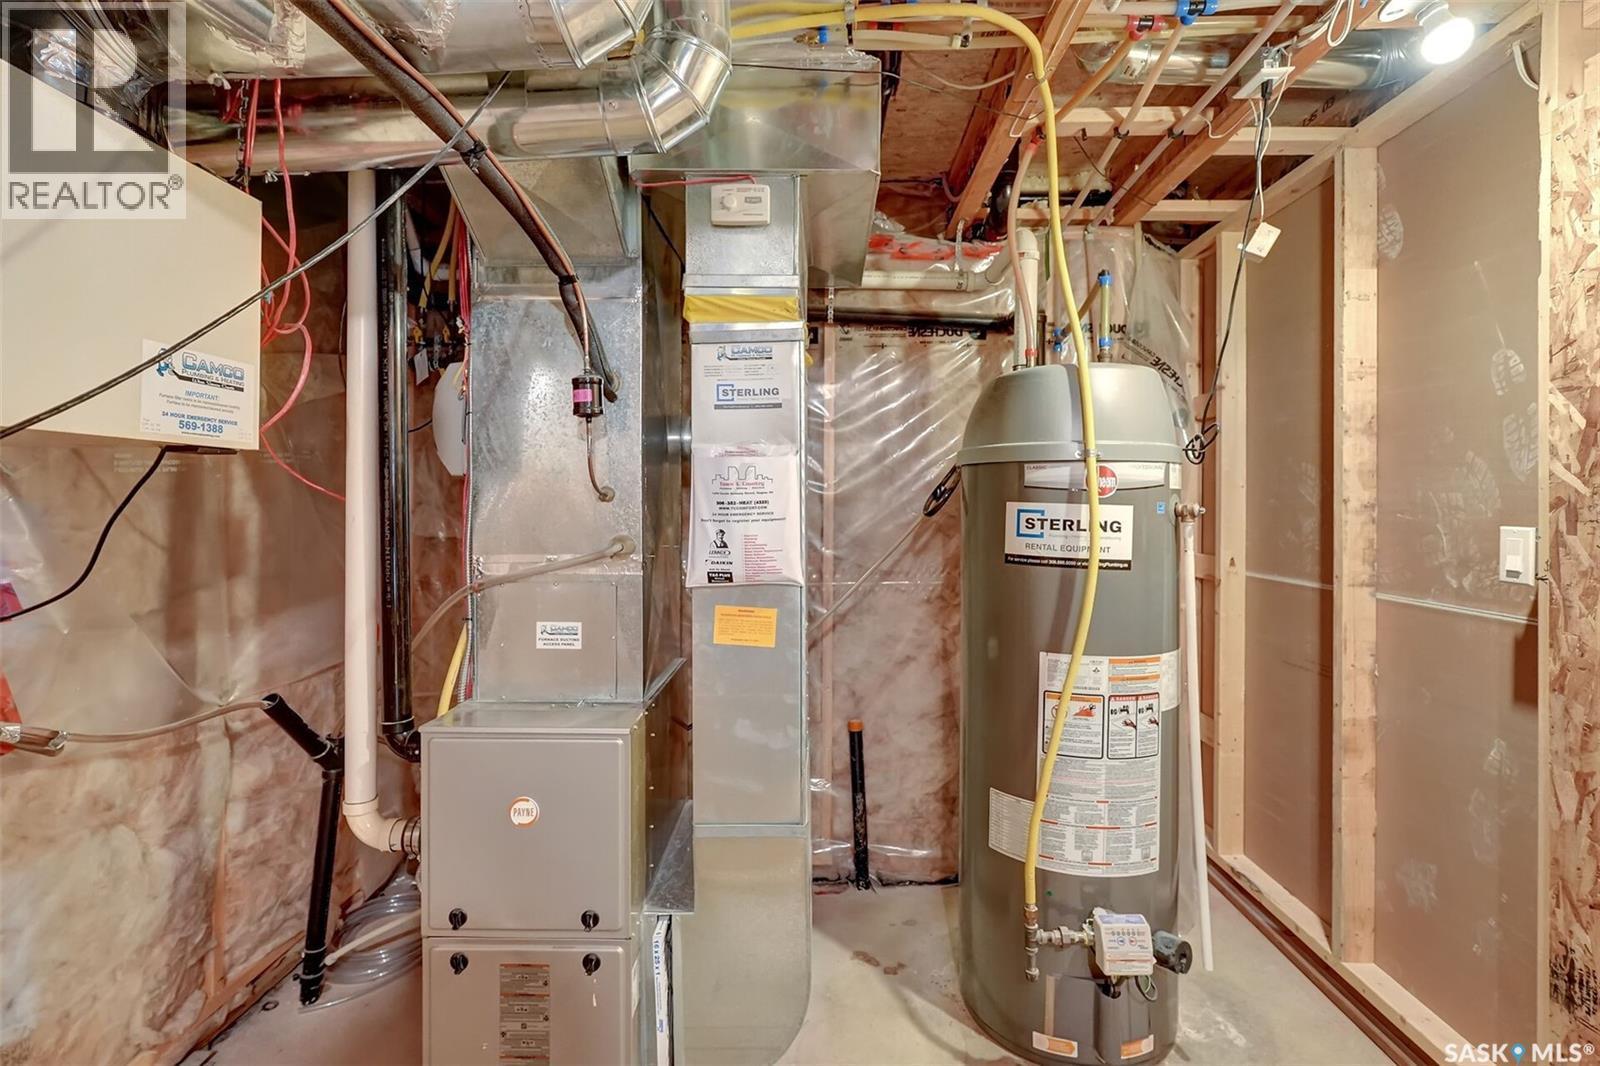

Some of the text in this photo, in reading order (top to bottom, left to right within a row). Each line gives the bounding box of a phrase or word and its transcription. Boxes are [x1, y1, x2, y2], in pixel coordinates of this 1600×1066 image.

[182, 351, 245, 381] CAMCO
[182, 368, 214, 381] PLUMBING
[722, 387, 780, 397] STERLING
[178, 419, 224, 434] 569-1388
[1025, 542, 1111, 554] RENTAL EQUIPNT
[513, 807, 535, 817] PAYNE
